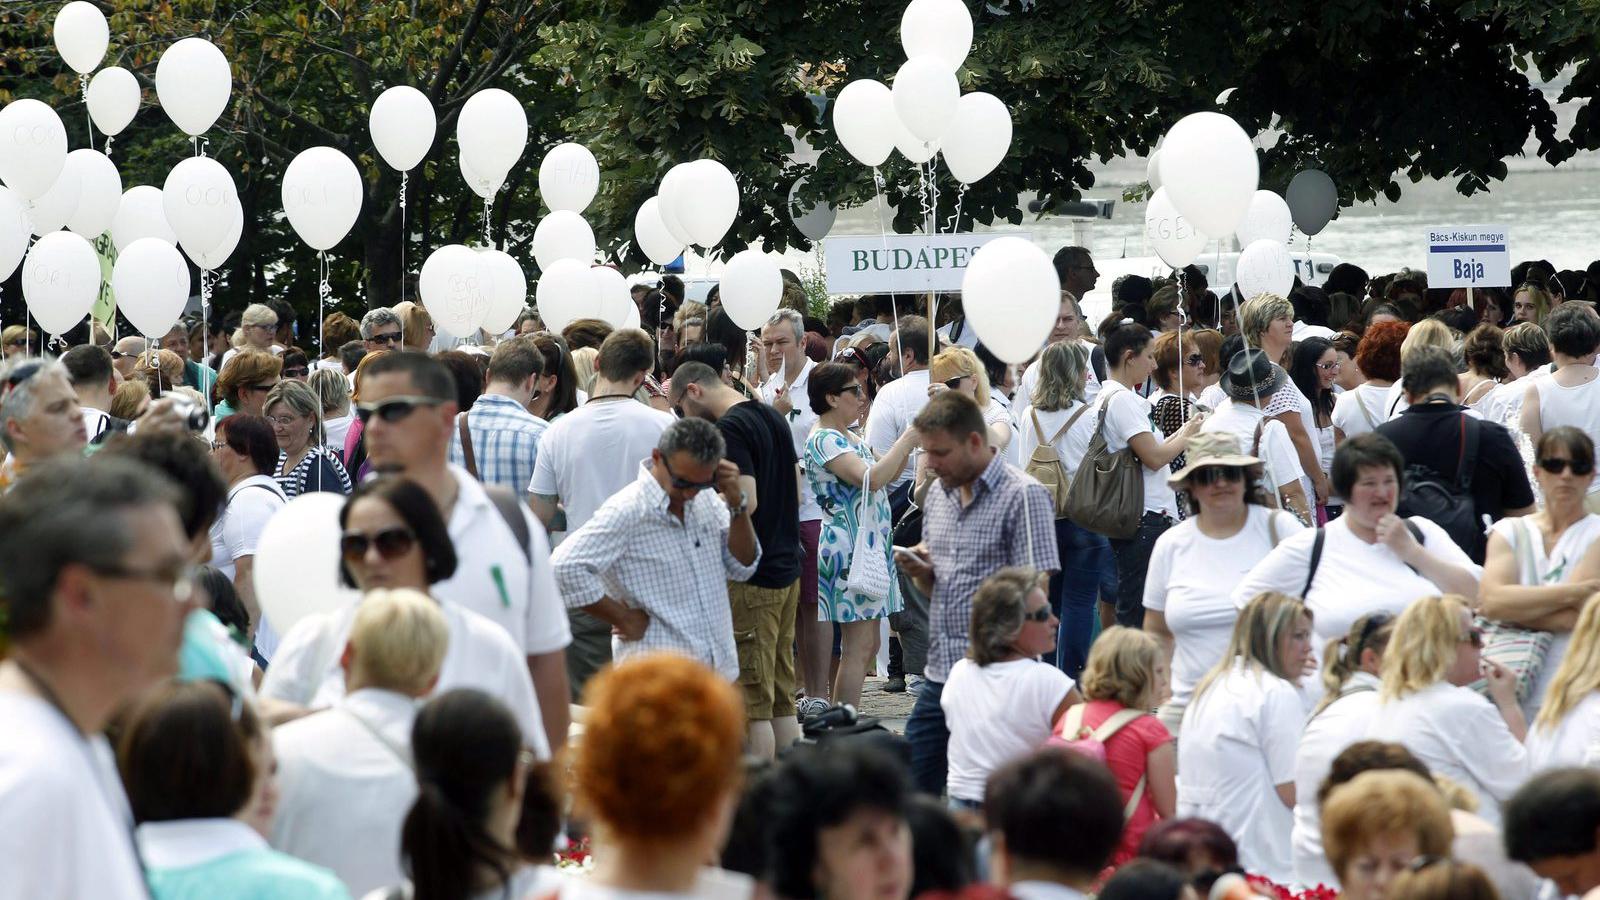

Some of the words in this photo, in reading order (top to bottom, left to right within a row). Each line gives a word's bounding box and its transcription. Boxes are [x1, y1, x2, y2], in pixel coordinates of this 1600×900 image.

[1430, 231, 1477, 242] Bács-Kiskun
[1479, 232, 1504, 243] megye
[1453, 258, 1485, 283] Baja
